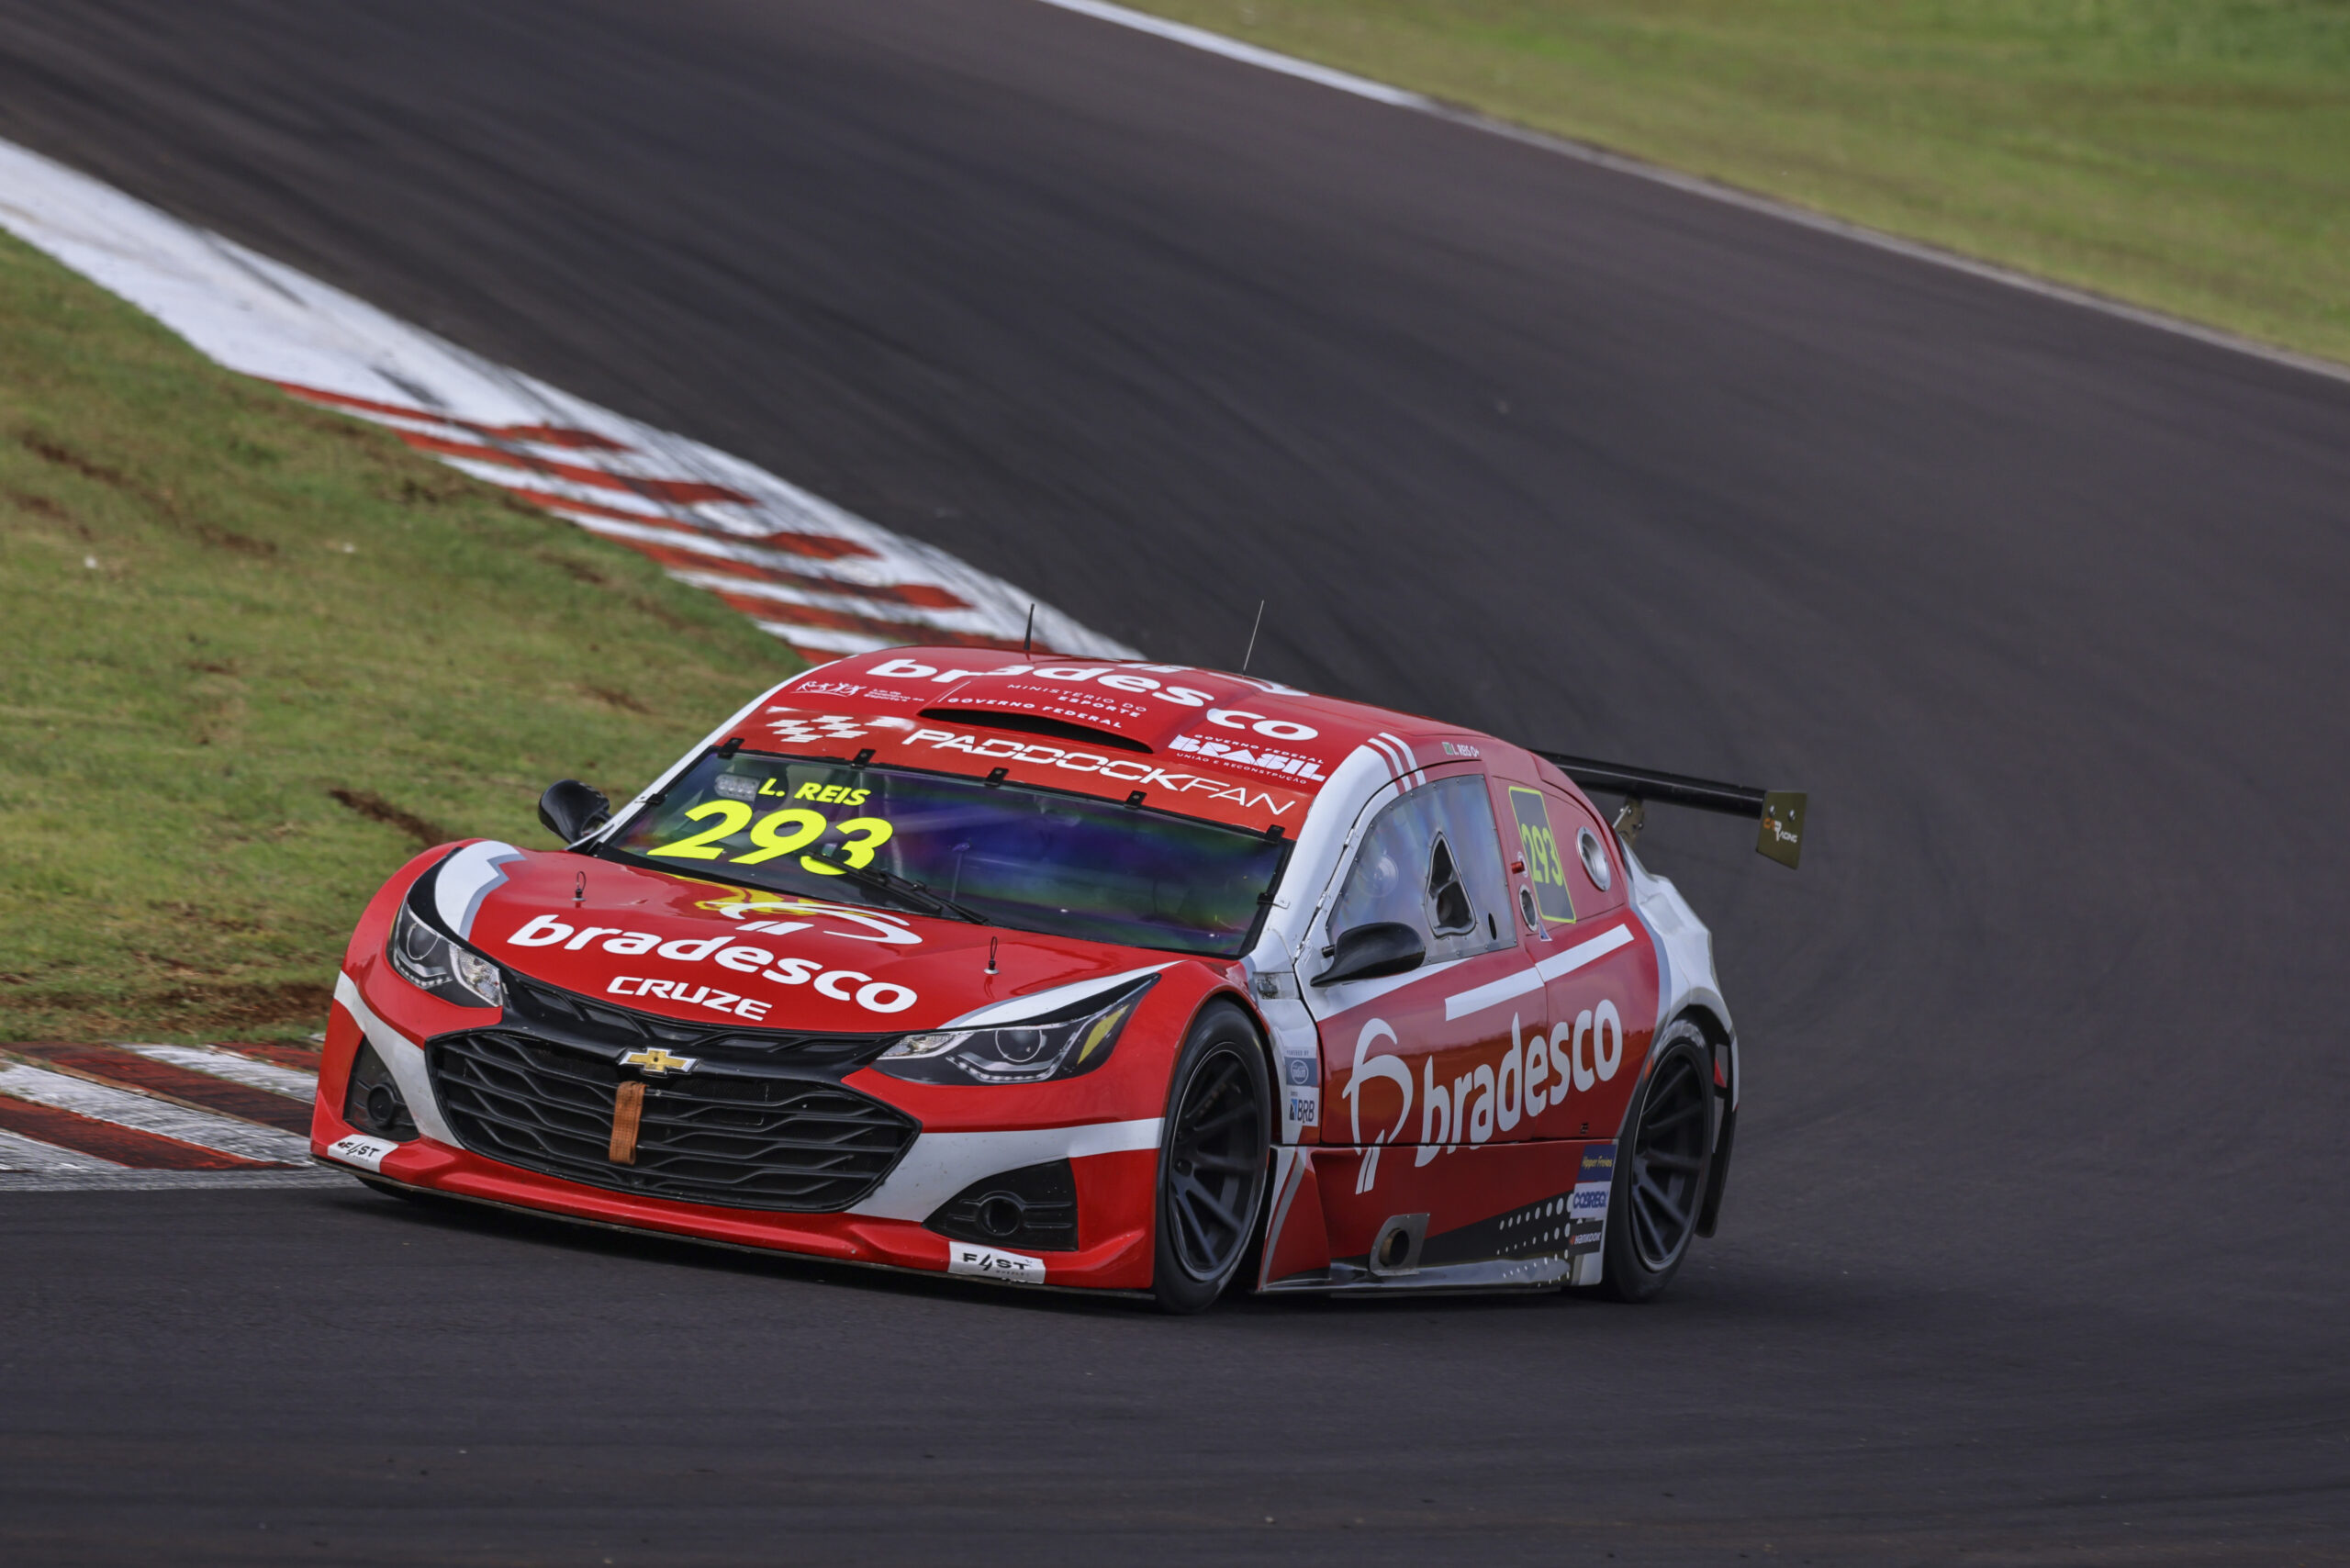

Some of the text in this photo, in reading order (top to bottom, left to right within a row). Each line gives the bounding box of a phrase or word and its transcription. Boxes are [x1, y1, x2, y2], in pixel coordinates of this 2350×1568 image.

[867, 657, 1319, 741] bradesco
[947, 697, 1122, 729] GOVERNO FEDERAL
[1058, 695, 1141, 718] ESPORTE
[1122, 702, 1147, 713] DO
[1168, 734, 1326, 782] BRASIL
[1176, 752, 1209, 763] UNIÃO
[1194, 734, 1325, 765] GOVERNO FEDERAL
[758, 778, 872, 807] L. REIS
[646, 799, 894, 876] 293
[1520, 823, 1563, 888] 293
[507, 914, 918, 1014] bradesco
[606, 975, 773, 1022] CRUZE
[1414, 998, 1623, 1169] bradesco
[1297, 1099, 1315, 1123] BRB
